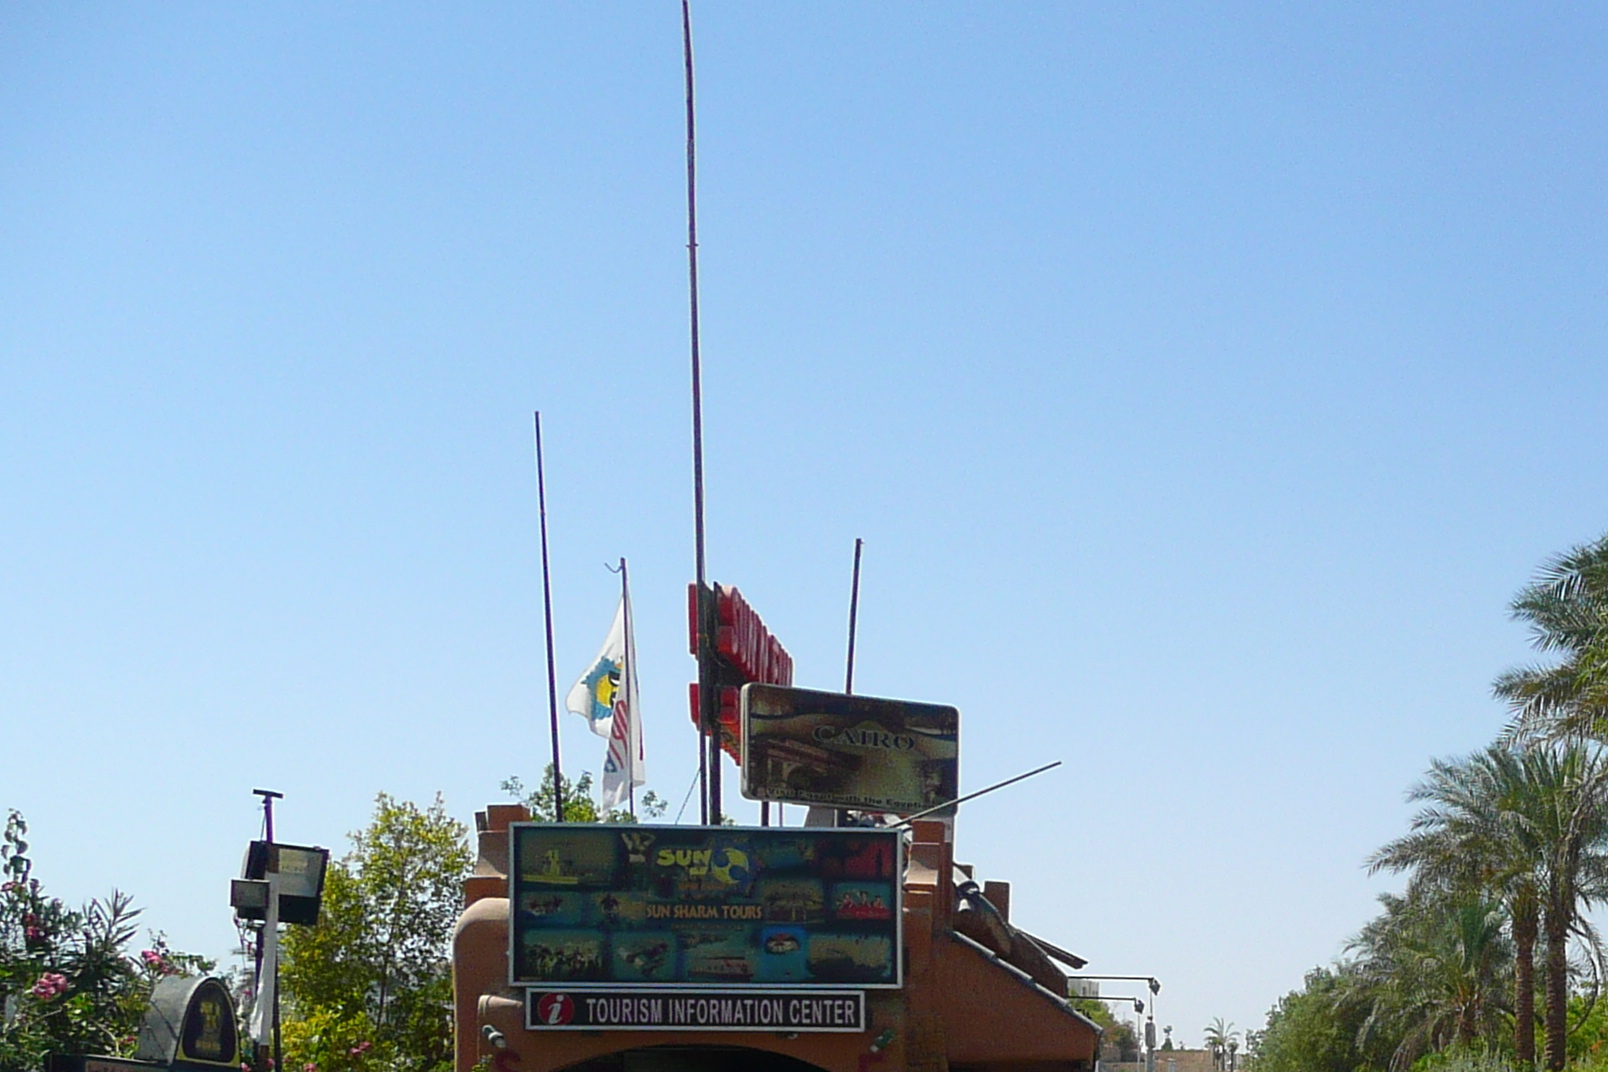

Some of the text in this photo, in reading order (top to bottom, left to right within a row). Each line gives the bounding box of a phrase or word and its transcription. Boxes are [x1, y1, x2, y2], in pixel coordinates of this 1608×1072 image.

[811, 725, 915, 750] CAIRO
[864, 796, 882, 805] the
[656, 848, 712, 867] SUN
[646, 904, 762, 919] SUN SHARM TOURS
[586, 998, 663, 1023] TOURISM
[668, 999, 783, 1024] INFORMATION
[789, 1000, 855, 1025] CENTER
